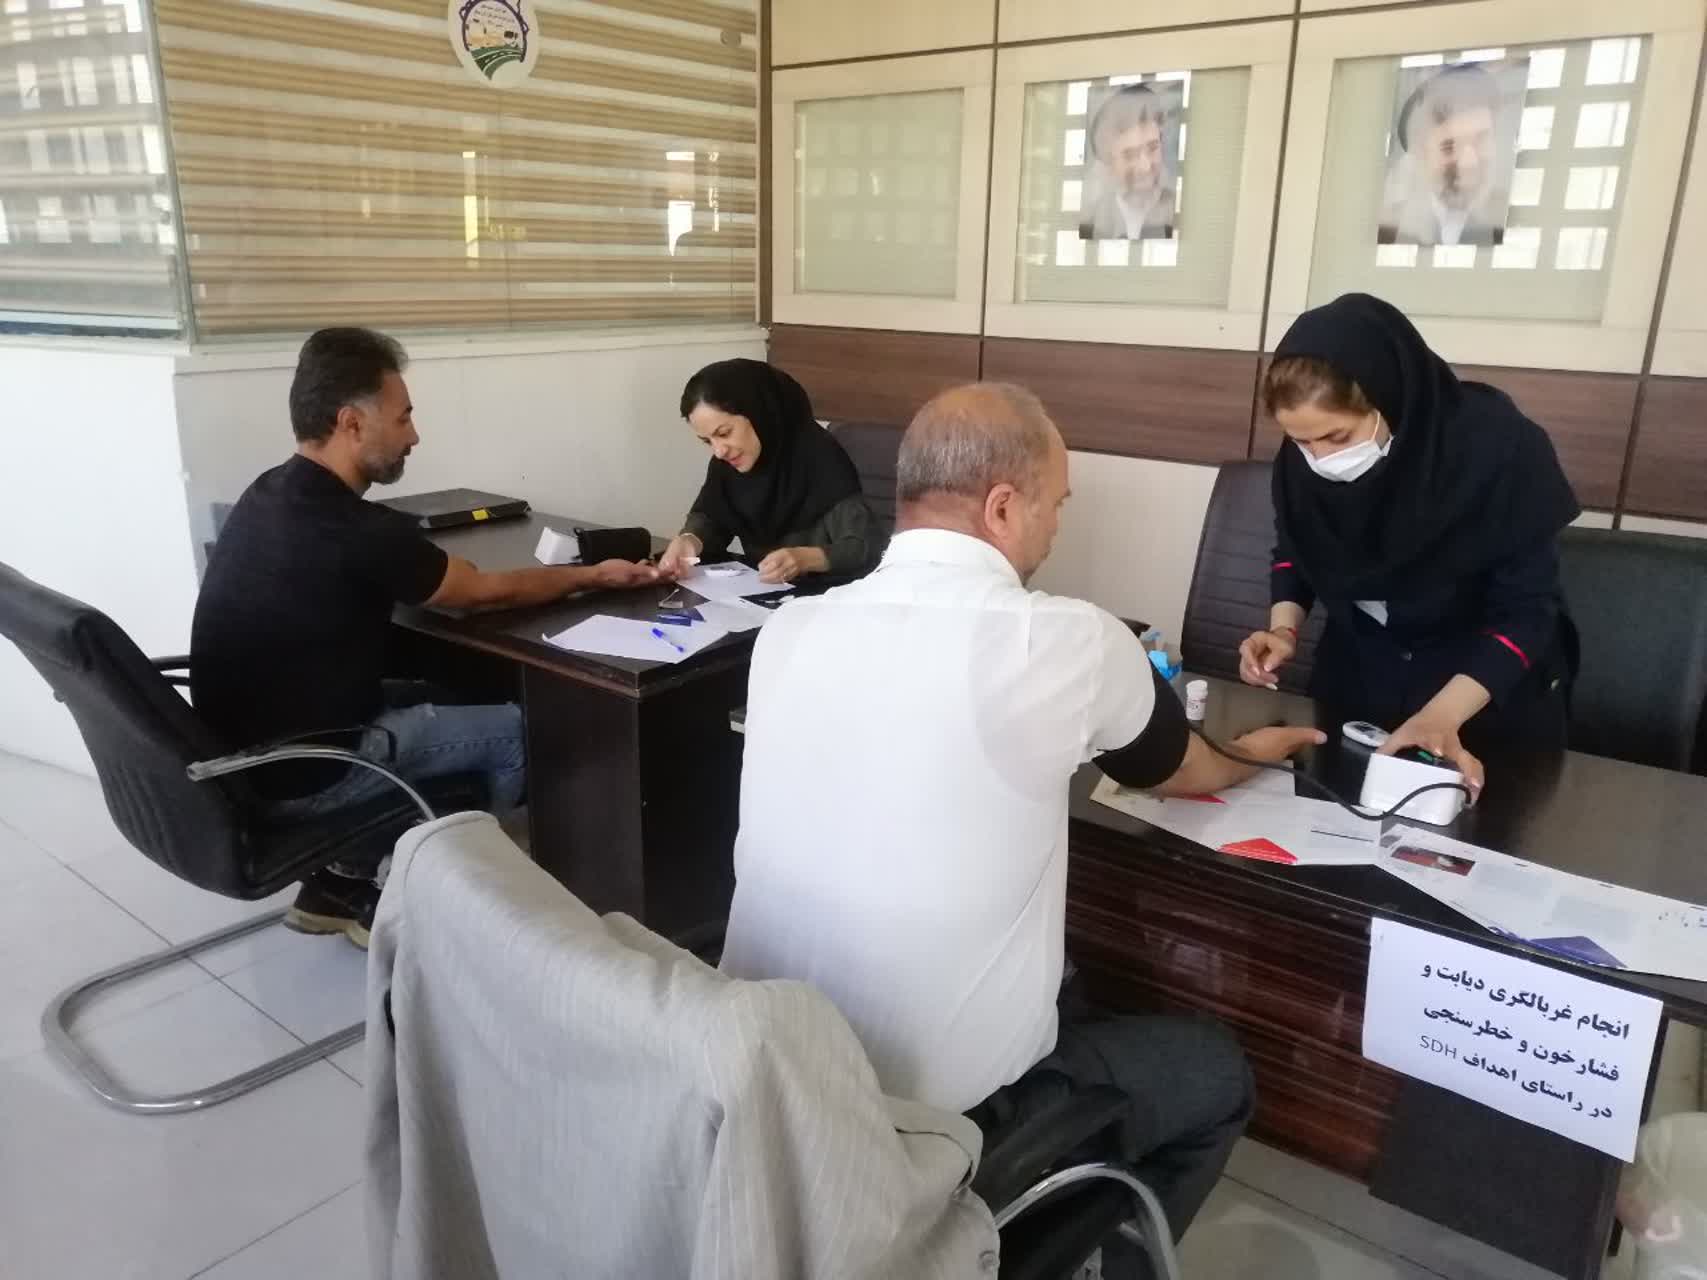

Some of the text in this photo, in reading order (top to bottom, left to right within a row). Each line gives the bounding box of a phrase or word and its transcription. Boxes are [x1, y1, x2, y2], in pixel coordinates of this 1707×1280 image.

[1420, 964, 1432, 979] و
[1436, 966, 1486, 992] دیابت
[1577, 1014, 1630, 1041] انجام
[1516, 1039, 1529, 1054] و
[1419, 1035, 1613, 1119] در راستای اهداف SDH
